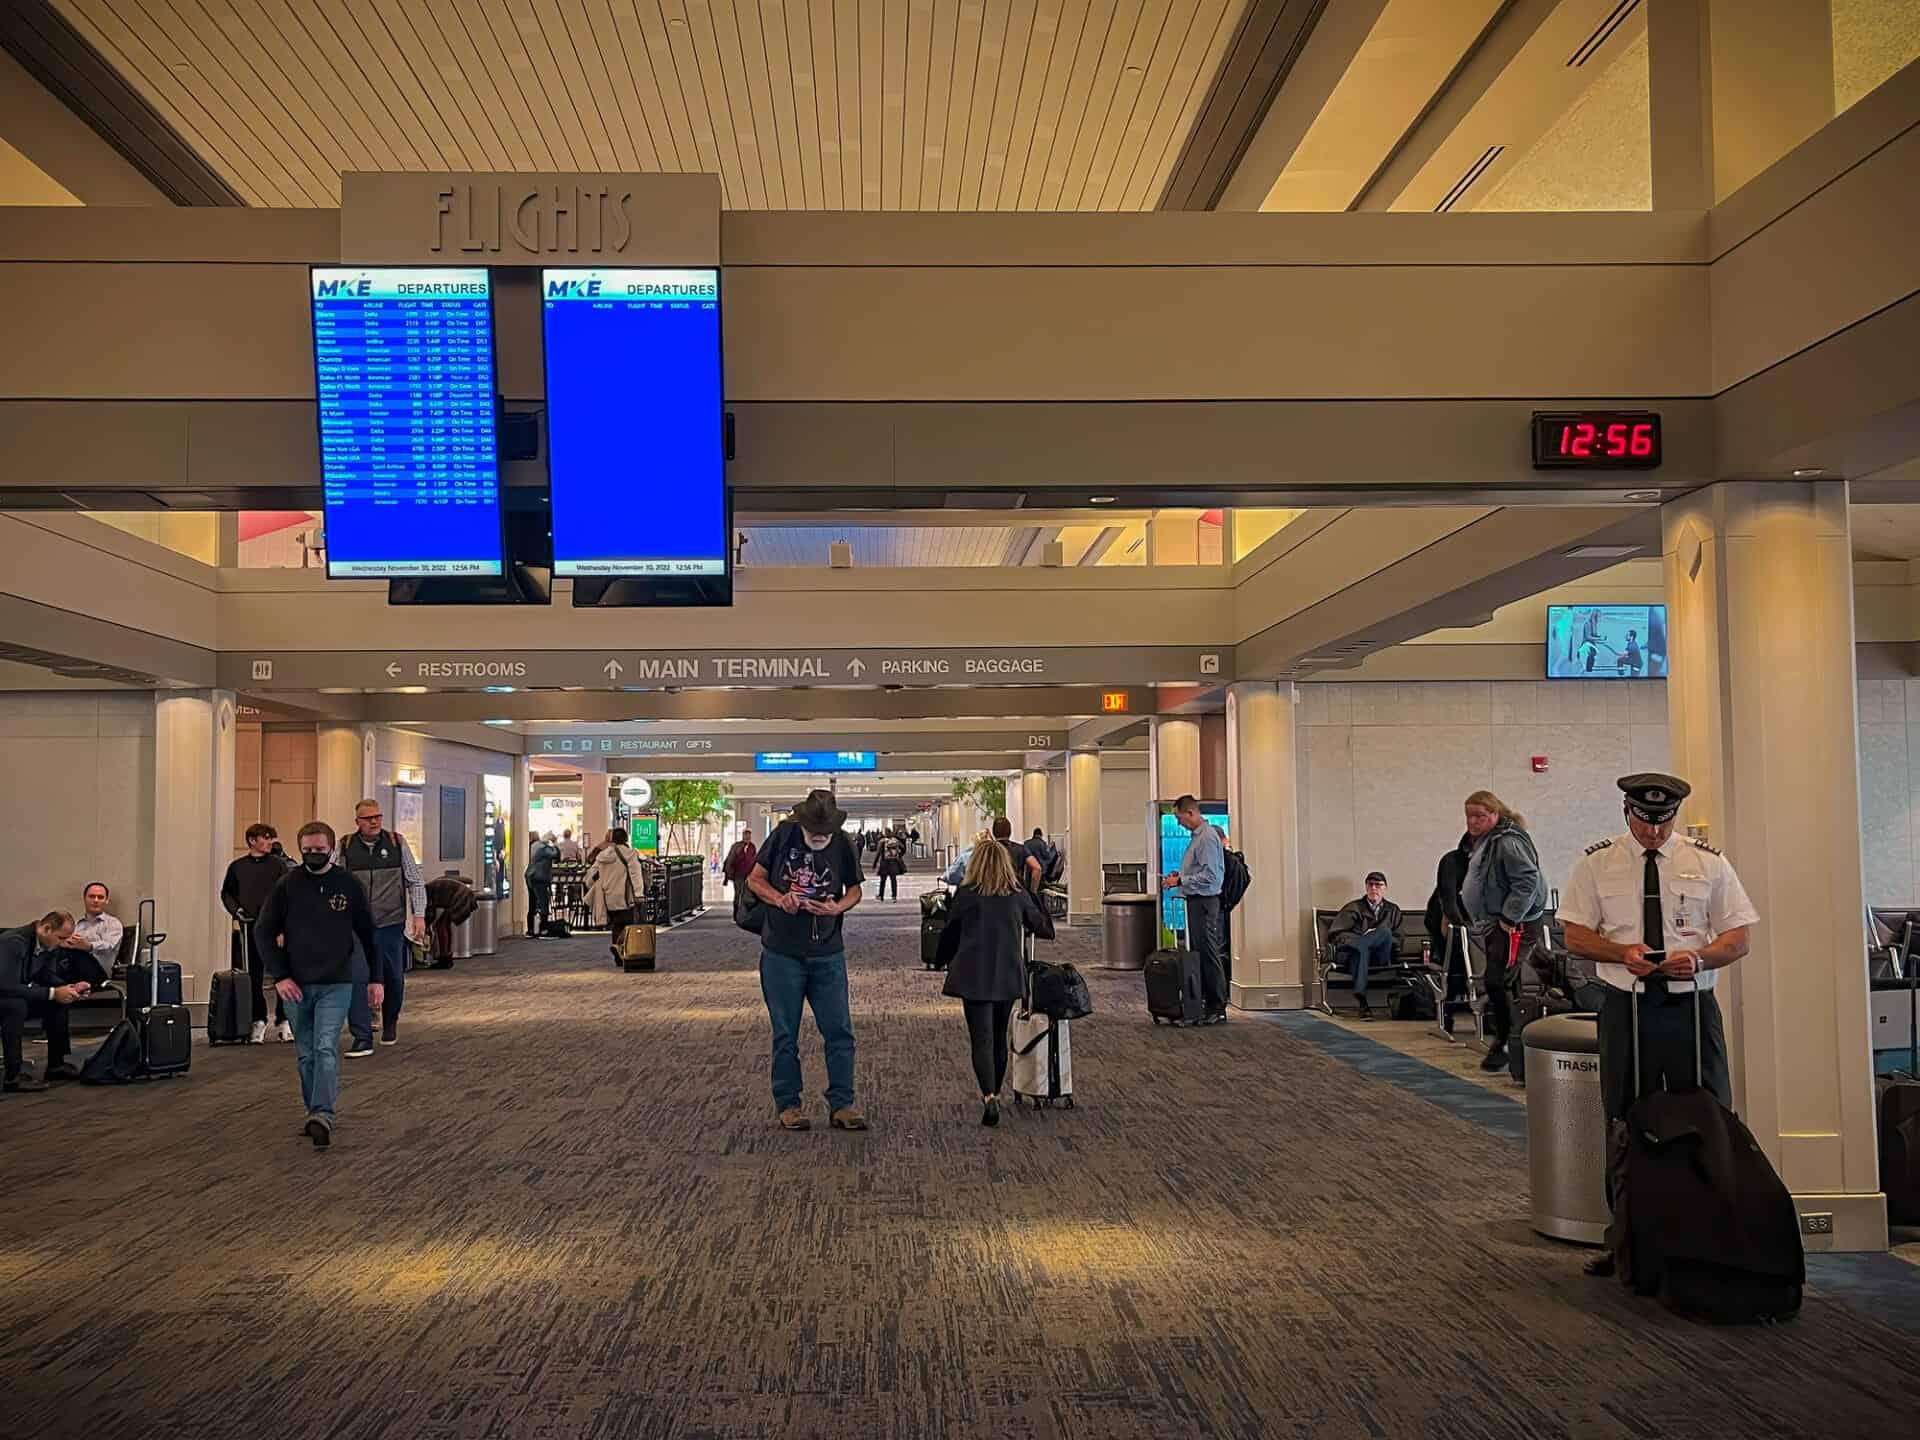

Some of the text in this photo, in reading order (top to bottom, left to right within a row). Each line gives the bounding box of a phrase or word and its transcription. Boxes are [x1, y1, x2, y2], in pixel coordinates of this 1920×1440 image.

[431, 185, 632, 253] FLIGHTS
[317, 276, 487, 297] MKE DEPARTURES
[547, 277, 716, 298] MKE DEPARTURES
[1561, 424, 1652, 455] 12:56
[417, 662, 526, 676] RESTROOMS
[639, 658, 830, 678] MAIN TERMINAL
[882, 660, 1044, 673] PARKING BAGGAGE
[1104, 694, 1125, 710] EXIT
[620, 740, 712, 750] RESTAURANT GIFTS
[1028, 736, 1051, 746] D51
[1556, 1059, 1598, 1072] TRASH
